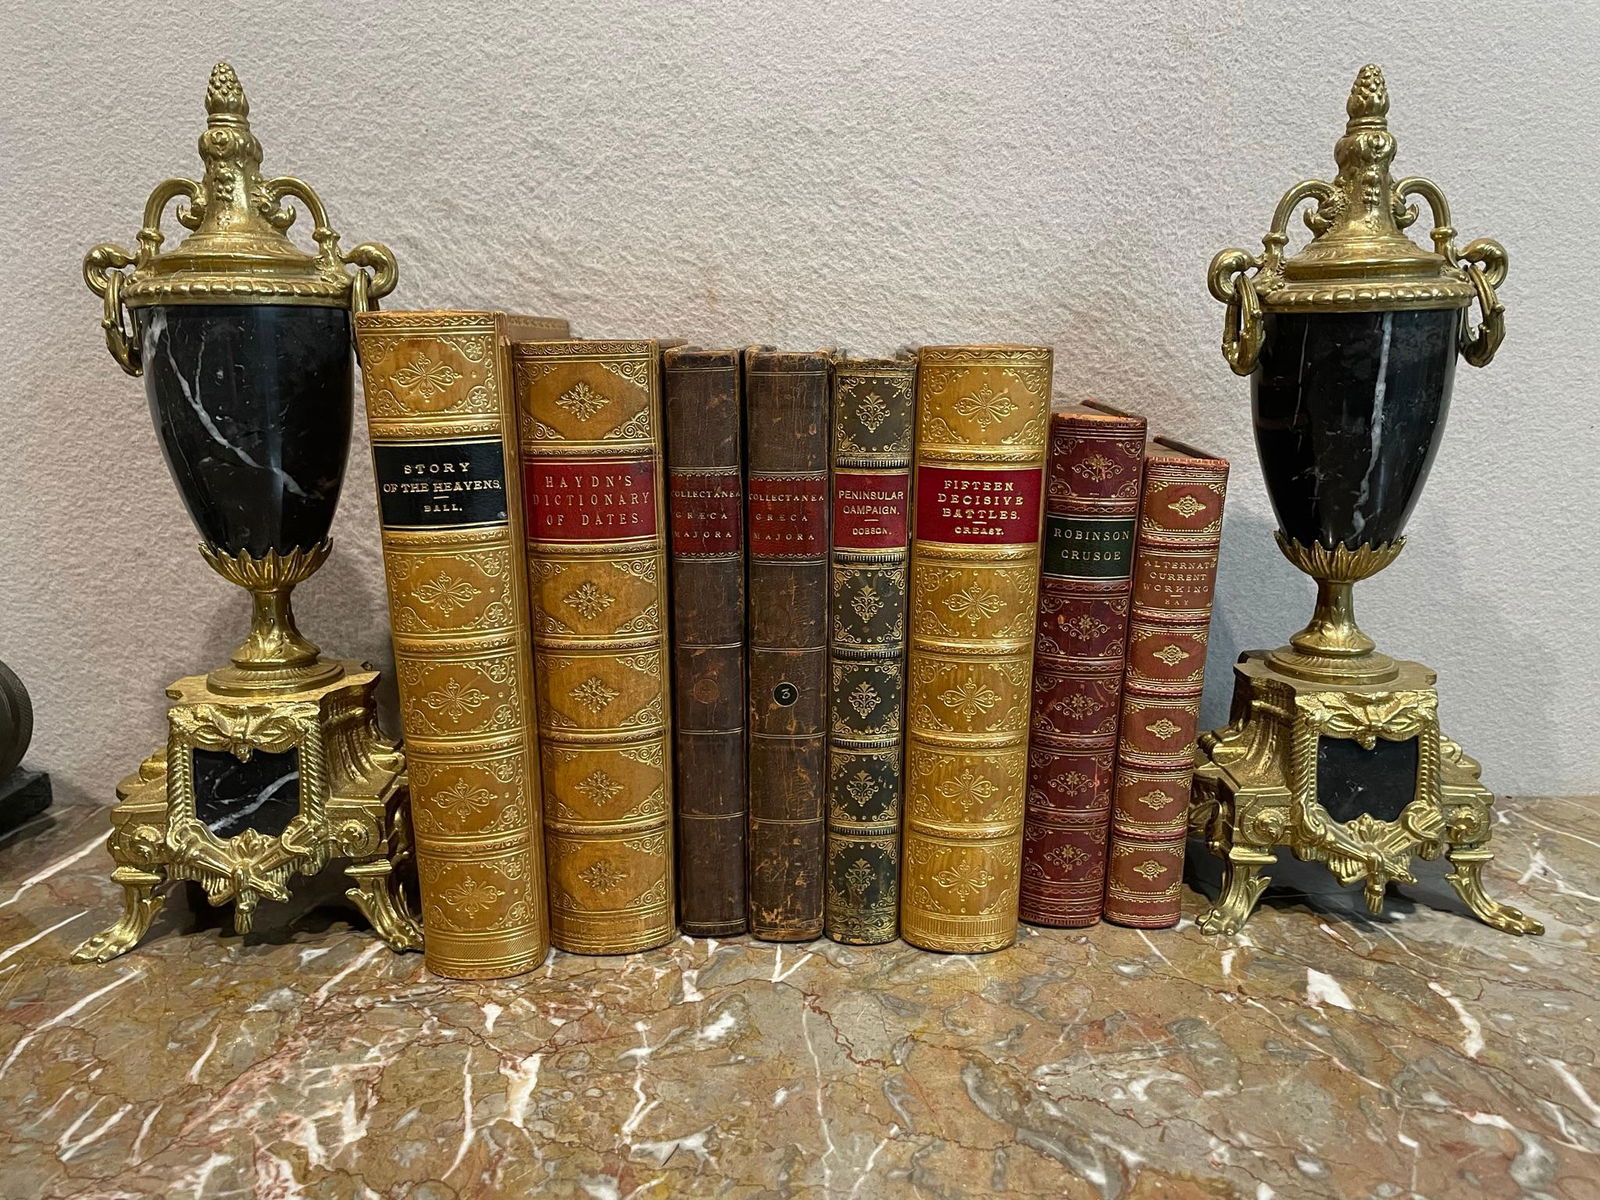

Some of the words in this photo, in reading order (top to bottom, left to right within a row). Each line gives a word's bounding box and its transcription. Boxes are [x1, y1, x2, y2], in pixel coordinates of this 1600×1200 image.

[404, 462, 470, 474] STORY
[545, 475, 633, 488] HAYDN'S
[944, 480, 1014, 491] FIFTEEN
[383, 483, 399, 493] OF
[400, 482, 429, 493] THE
[533, 492, 650, 506] DICTIONARY
[749, 493, 824, 502] COLLECTANEA
[838, 490, 904, 500] PENINSULAR
[937, 493, 1024, 506] DECISIVE
[424, 504, 463, 513] BALL.
[843, 505, 900, 515] CAMPAIGN.
[942, 507, 1020, 520] BATTLES.
[546, 514, 565, 526] OF
[581, 512, 644, 526] DATES.
[753, 532, 815, 541] MAJORA
[1053, 527, 1130, 541] ROBINSON
[1061, 549, 1121, 561] CRUSOE
[1149, 572, 1207, 581] CURRENT
[1143, 583, 1209, 593] WORKING
[781, 688, 791, 699] 3
